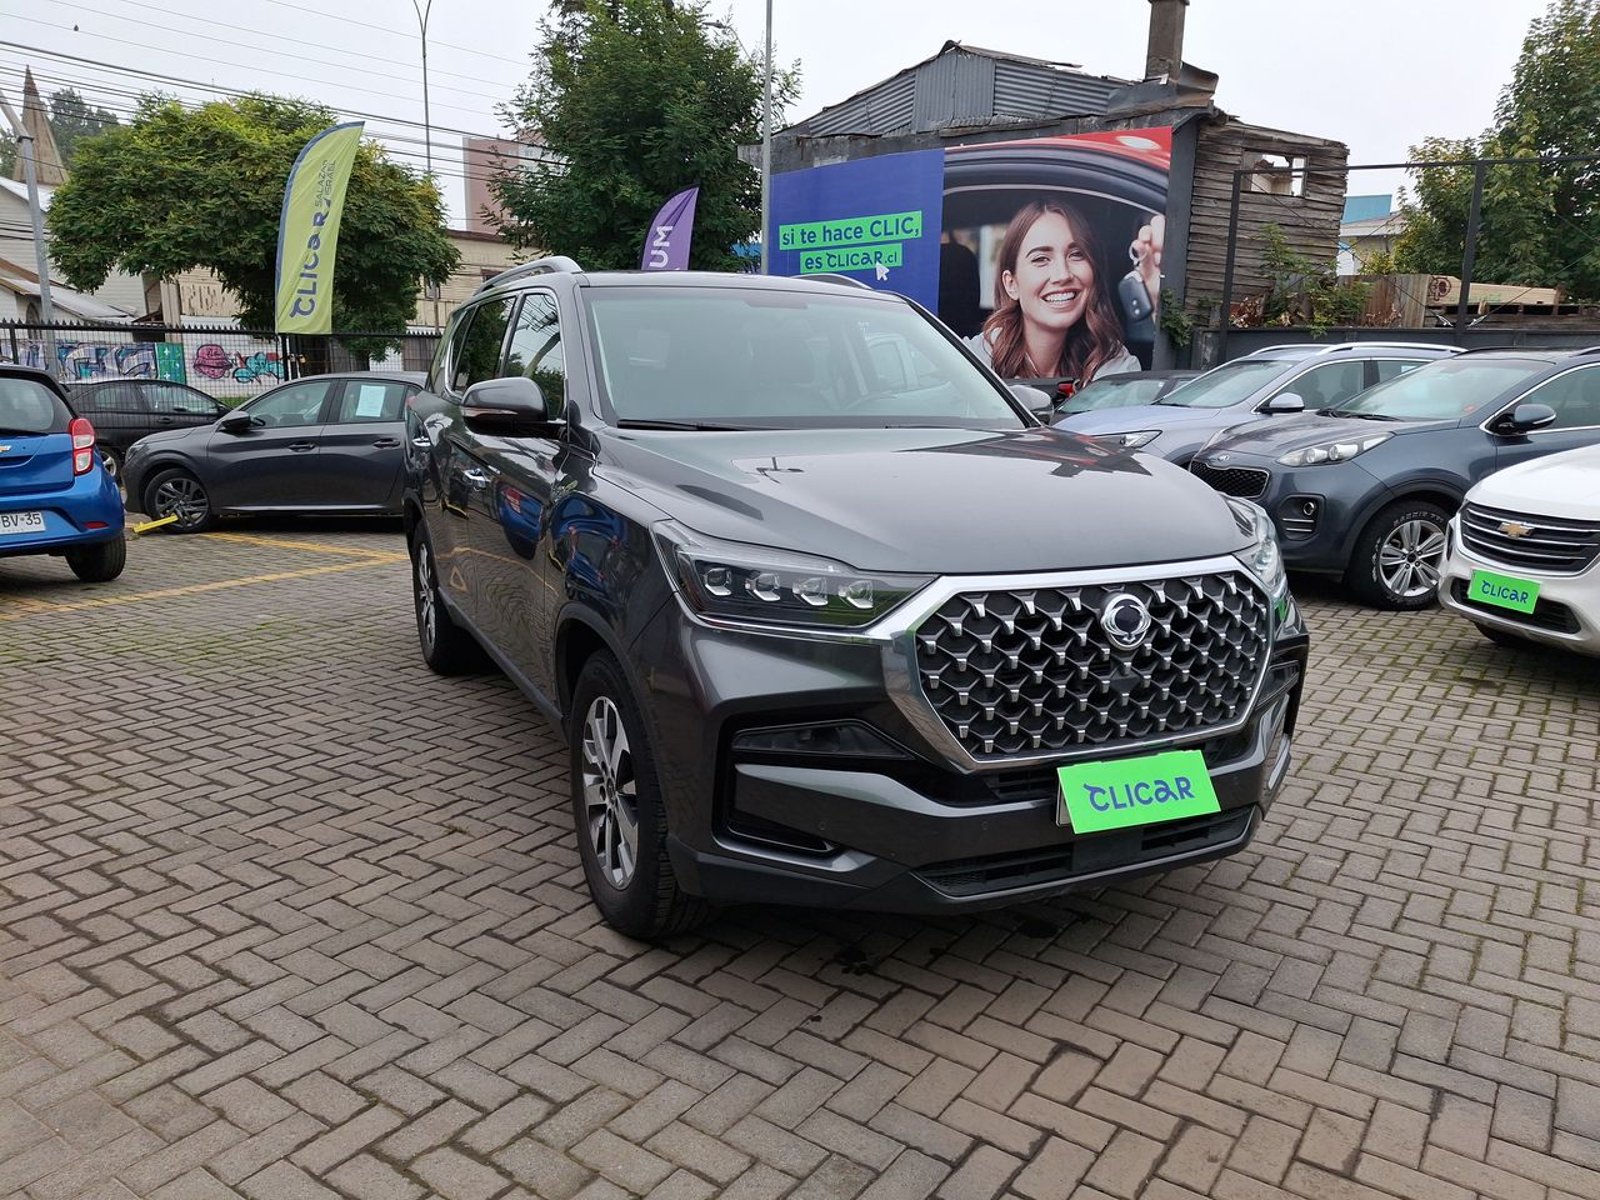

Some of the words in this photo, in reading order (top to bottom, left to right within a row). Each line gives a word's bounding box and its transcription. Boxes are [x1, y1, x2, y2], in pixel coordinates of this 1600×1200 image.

[782, 229, 795, 245] si
[800, 229, 817, 244] te
[823, 225, 864, 242] hace
[870, 217, 919, 237] CLIC,
[805, 256, 823, 269] es
